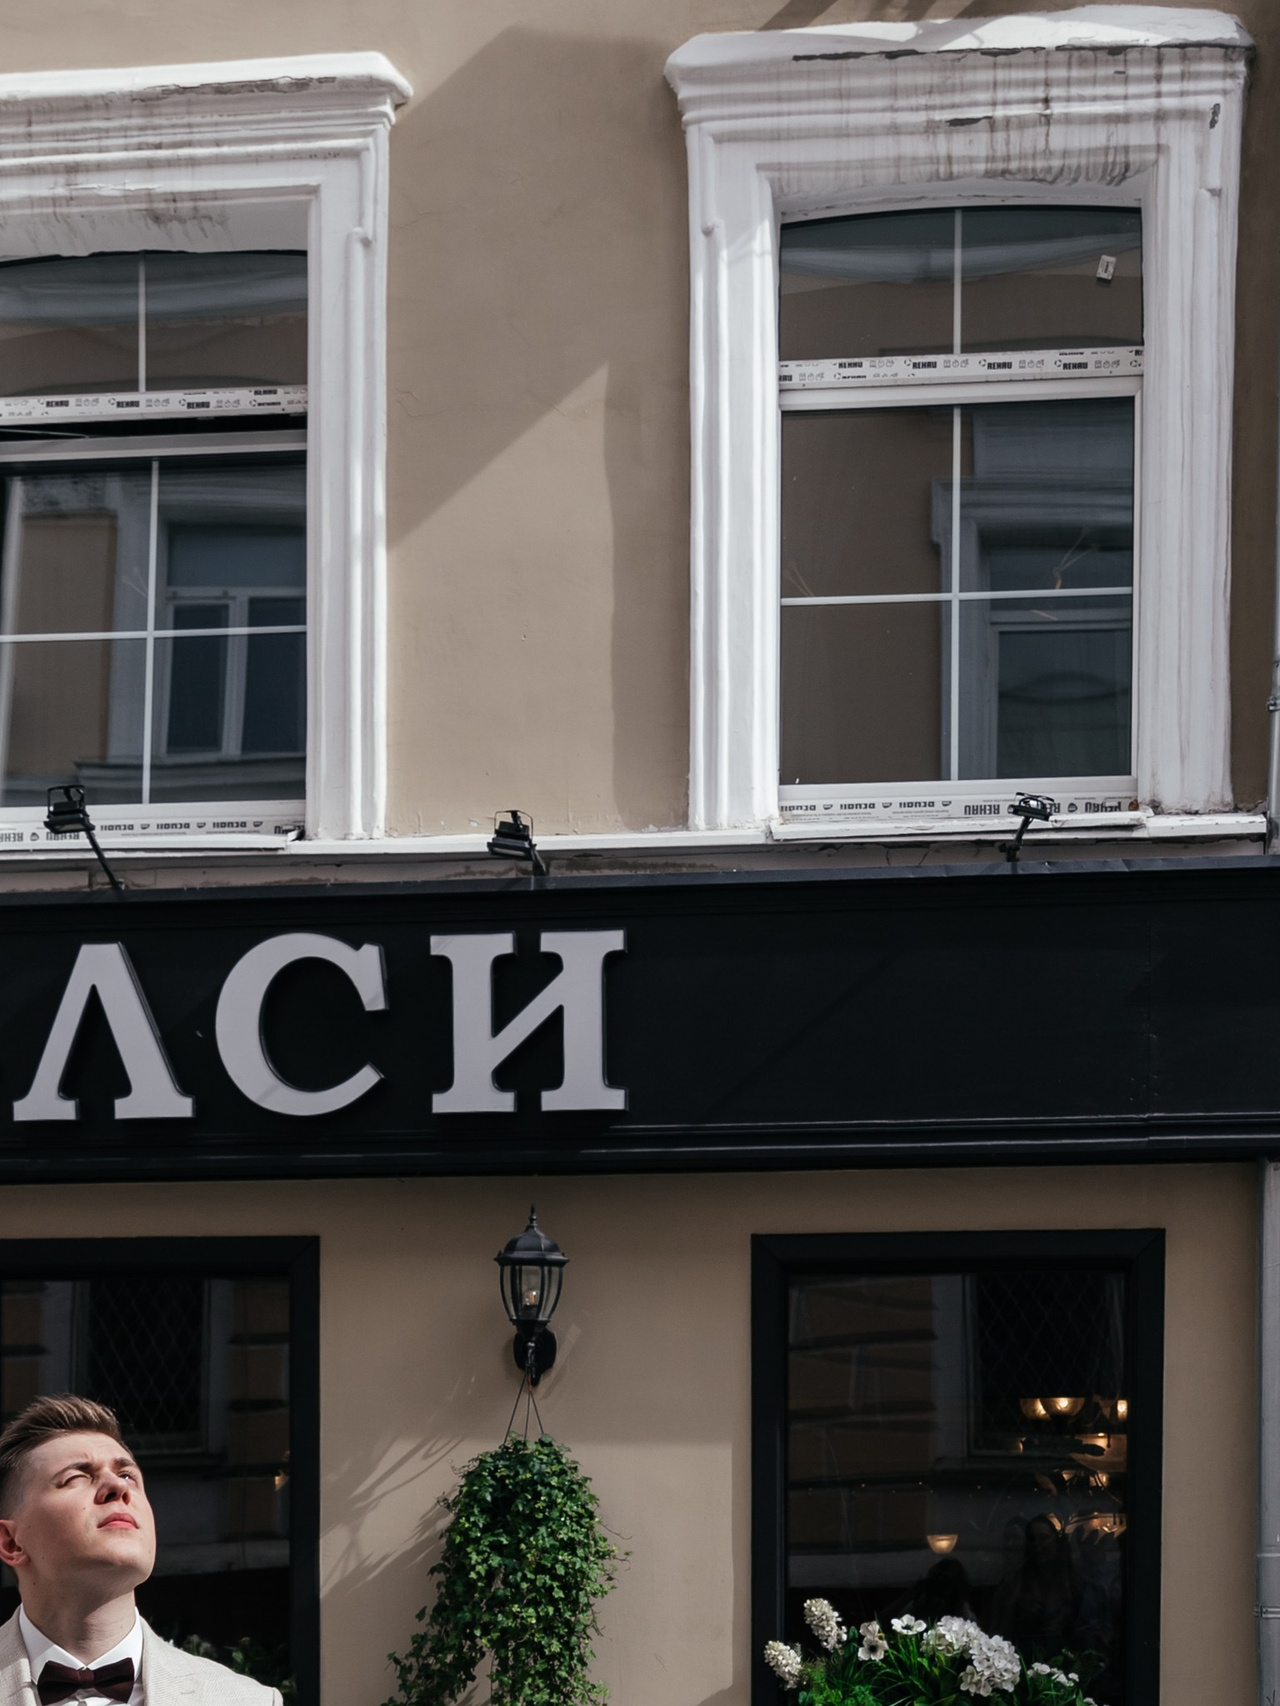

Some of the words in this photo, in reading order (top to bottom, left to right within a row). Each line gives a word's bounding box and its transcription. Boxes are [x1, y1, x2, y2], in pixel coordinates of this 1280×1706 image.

[911, 361, 937, 369] REHAU
[987, 361, 1012, 370] REHAU
[1062, 362, 1088, 370] REHAU
[964, 804, 1000, 815] REHAU
